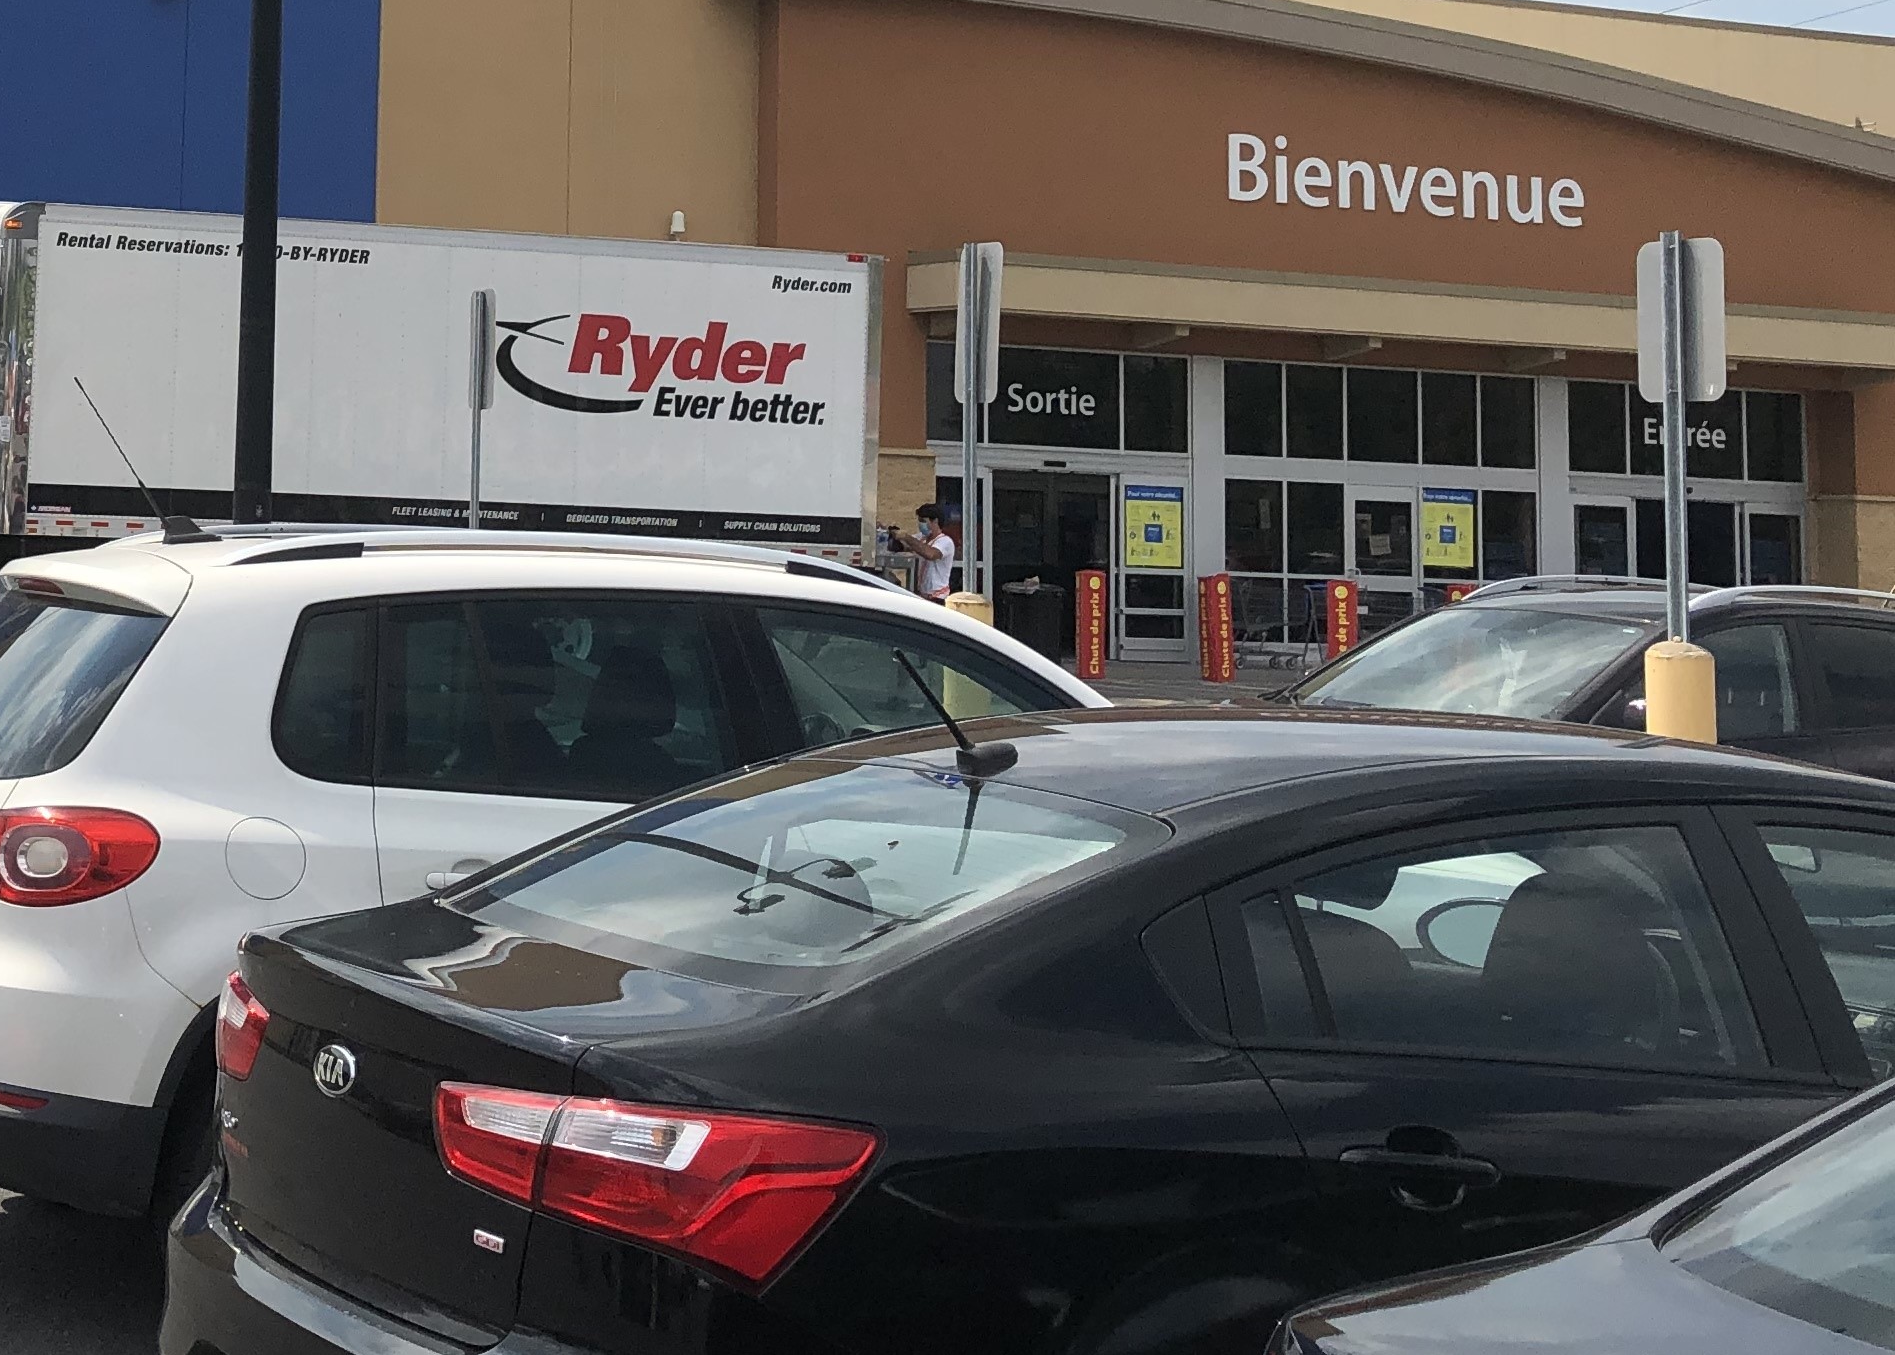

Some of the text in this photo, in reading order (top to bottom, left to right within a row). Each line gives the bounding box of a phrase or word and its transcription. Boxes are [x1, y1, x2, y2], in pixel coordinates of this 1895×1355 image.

[1226, 132, 1586, 228] Bienvenue
[56, 232, 112, 250] Rental
[116, 235, 230, 257] Reservations:
[771, 275, 852, 294] Ryder.com
[567, 313, 807, 393] Ryder
[653, 387, 826, 426] Ever better.
[1007, 383, 1096, 416] Sortie
[1643, 417, 1727, 449] Erée
[392, 506, 417, 516] FLEET
[418, 507, 452, 518] LEASING
[566, 513, 679, 527] DEDICATED TRANSPORTATION
[724, 520, 821, 533] SUPPLY CHAIN SOLUTIONS
[1335, 601, 1350, 625] prix
[1089, 592, 1102, 674] Chute de prix
[1218, 597, 1230, 678] Chute de prix
[1335, 627, 1348, 643] de
[317, 1051, 344, 1087] KIA
